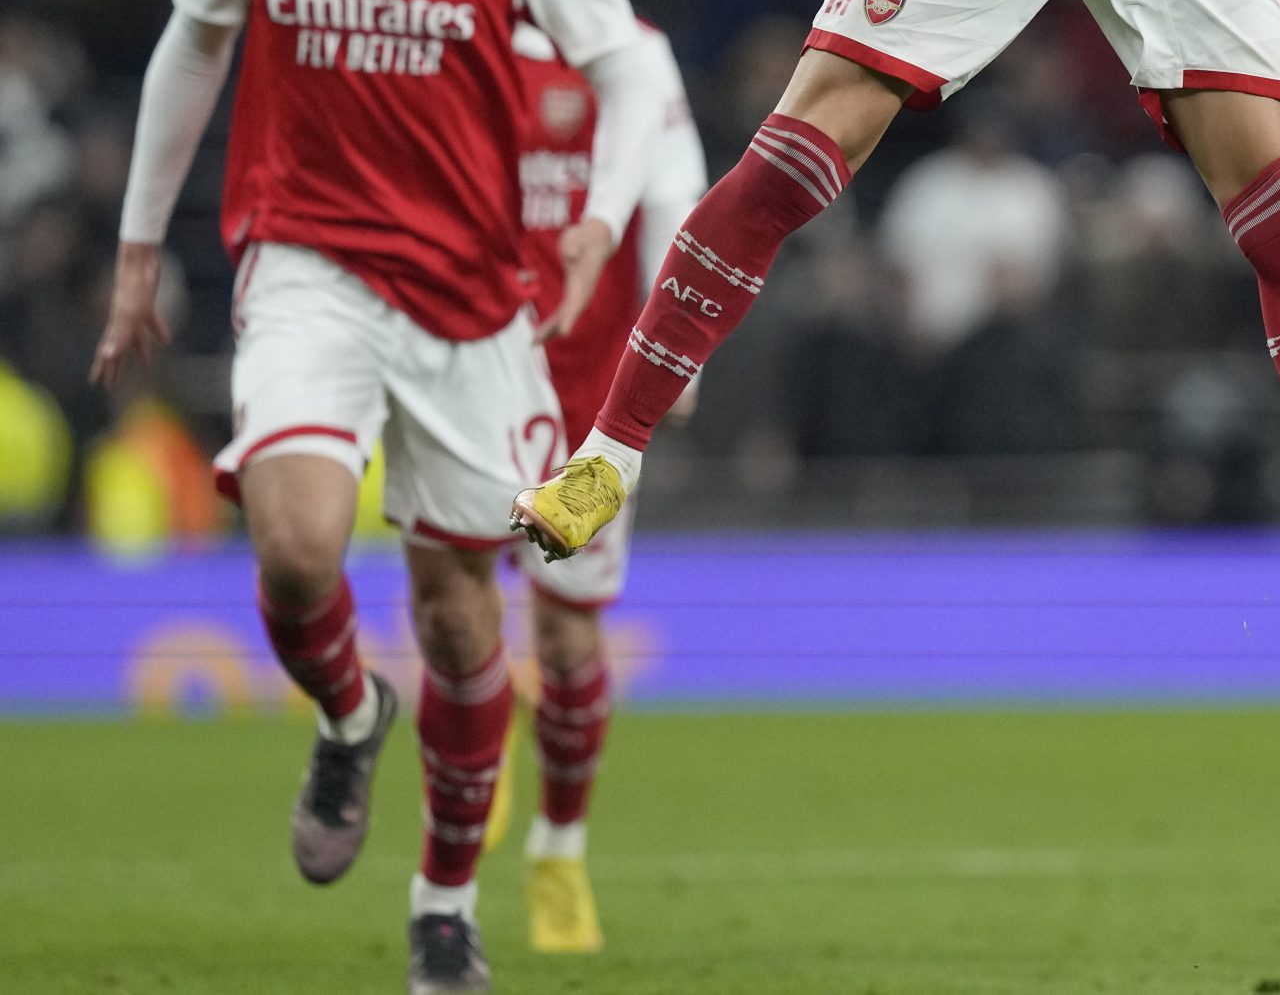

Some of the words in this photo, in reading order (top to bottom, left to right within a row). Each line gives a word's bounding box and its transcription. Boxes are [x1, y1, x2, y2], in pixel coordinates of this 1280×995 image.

[296, 28, 341, 69] FLY
[346, 32, 444, 76] BETTER
[661, 277, 722, 317] AFC
